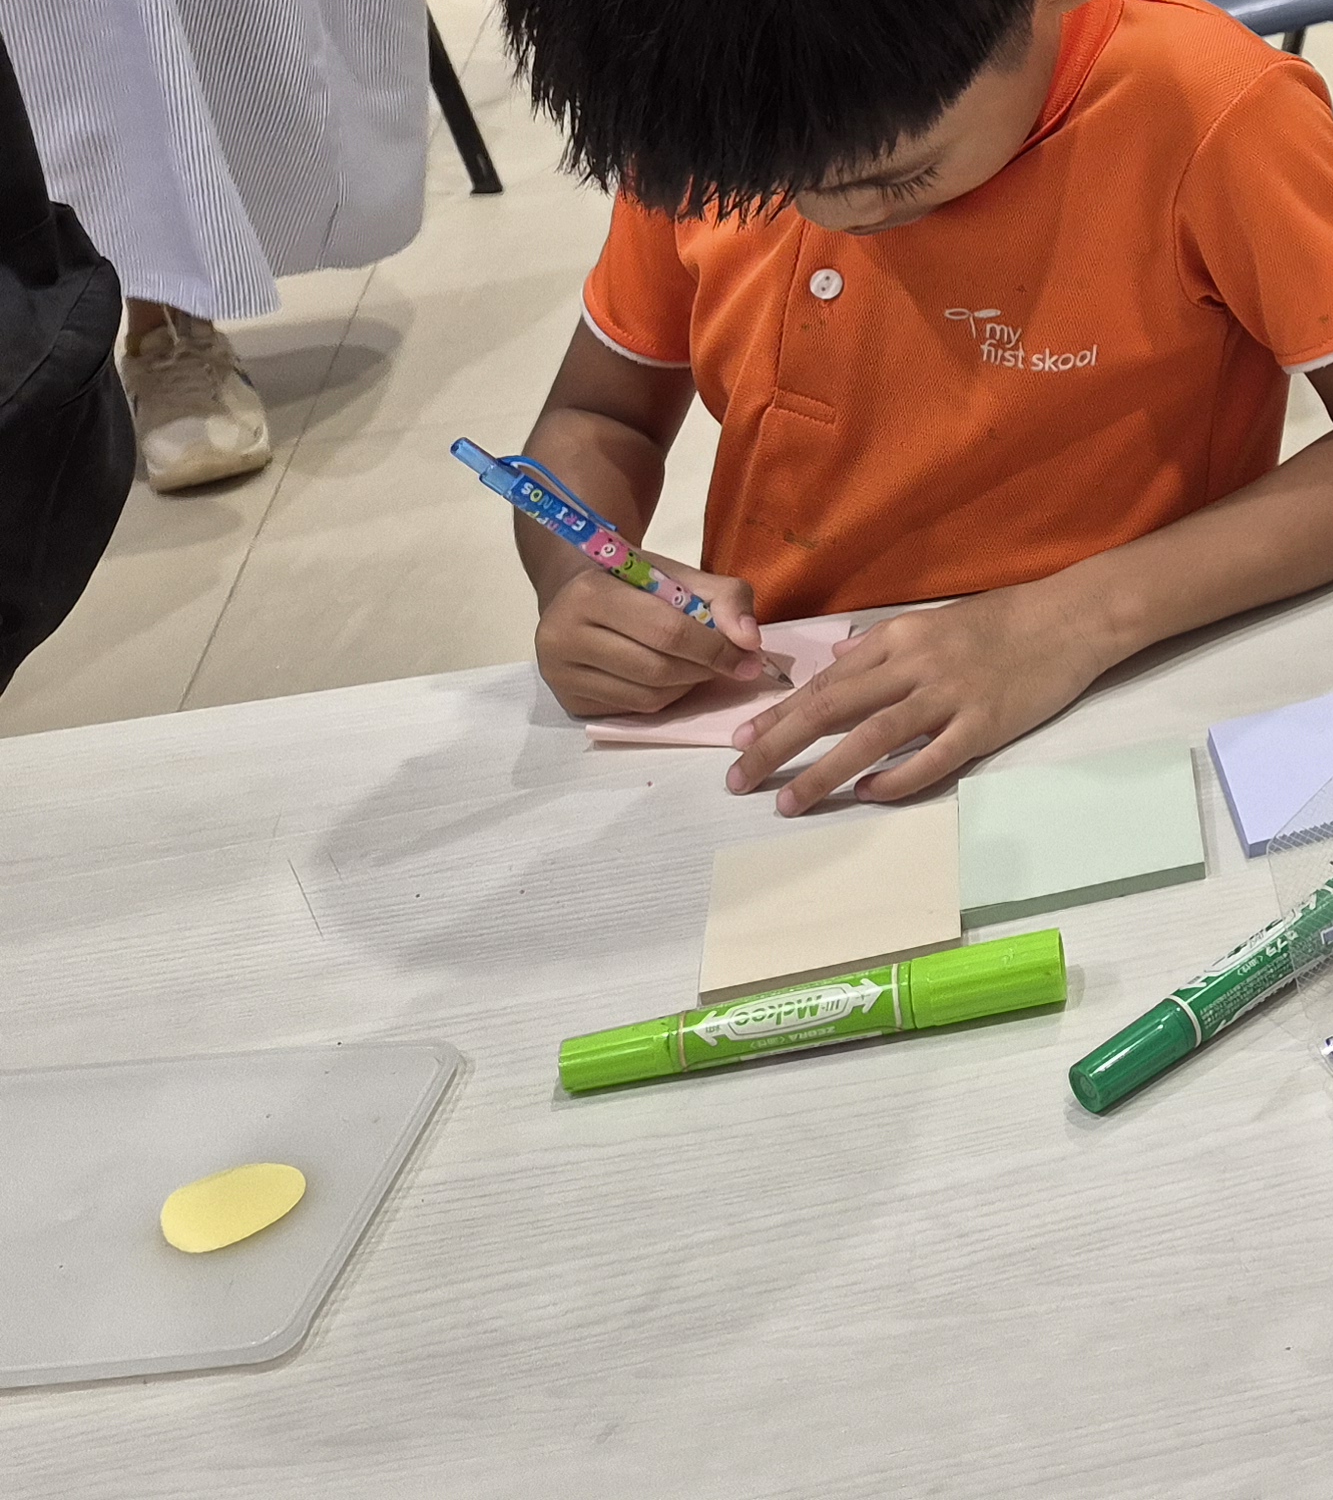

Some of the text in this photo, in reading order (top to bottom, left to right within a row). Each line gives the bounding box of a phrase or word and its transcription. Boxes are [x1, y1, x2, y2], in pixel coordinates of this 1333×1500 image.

[985, 323, 1022, 348] my
[980, 340, 1098, 372] first skool
